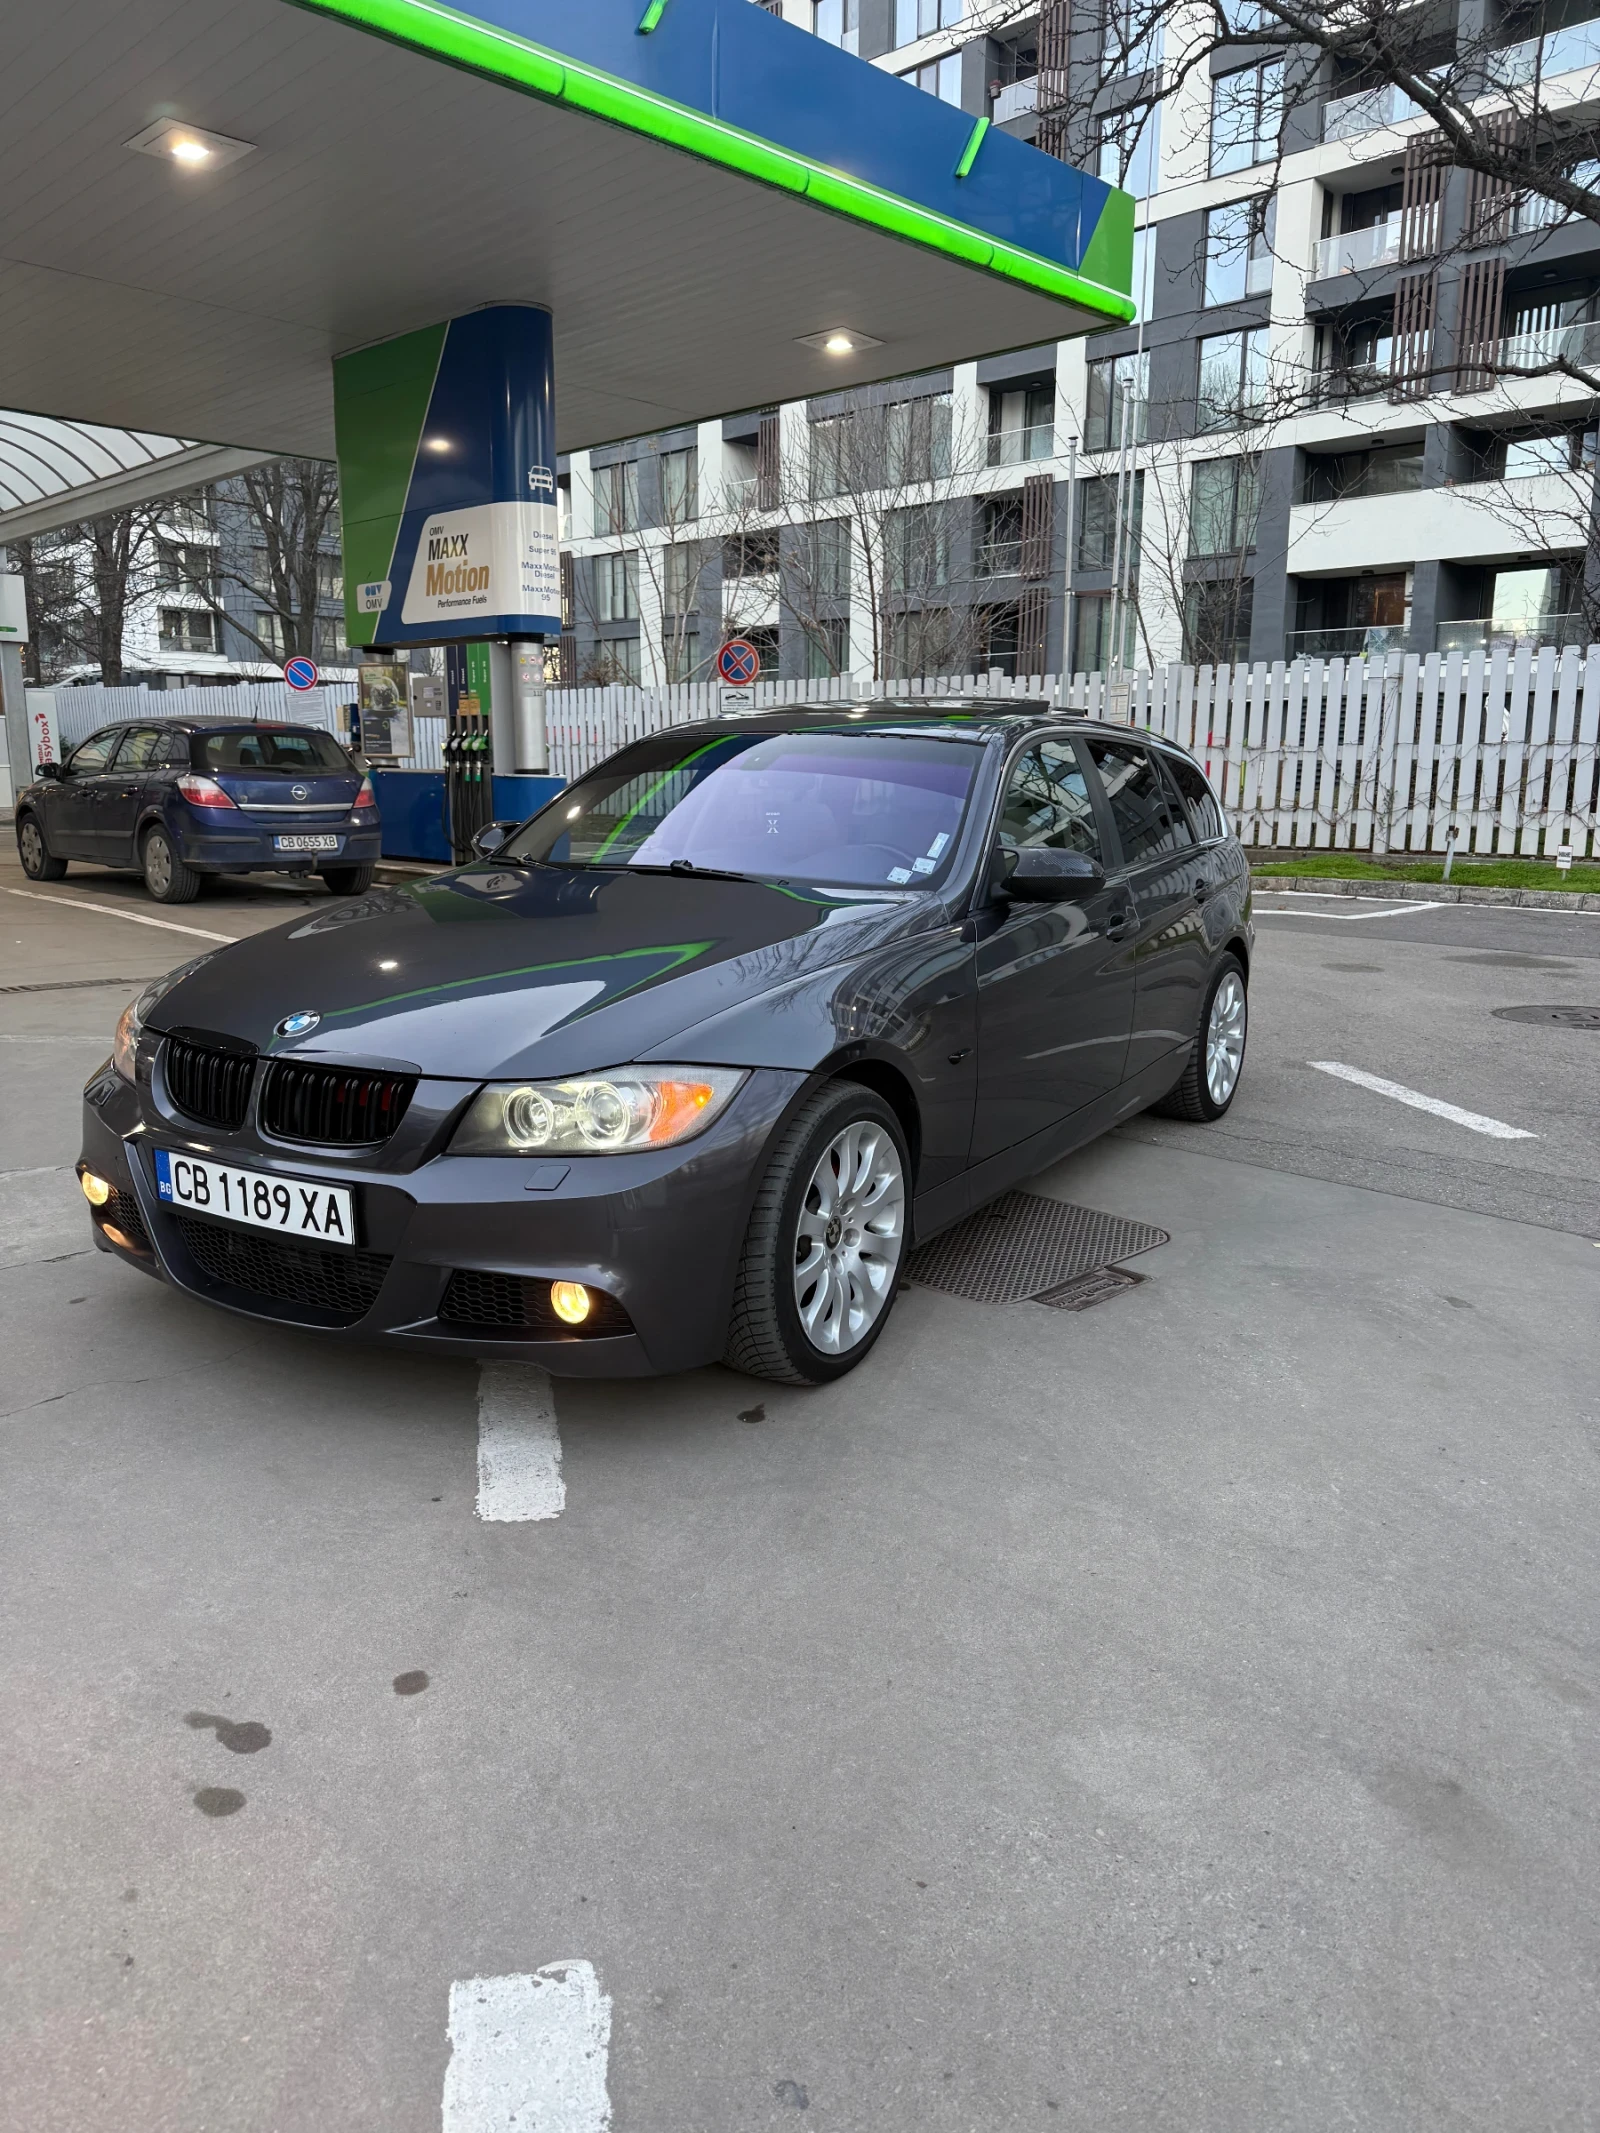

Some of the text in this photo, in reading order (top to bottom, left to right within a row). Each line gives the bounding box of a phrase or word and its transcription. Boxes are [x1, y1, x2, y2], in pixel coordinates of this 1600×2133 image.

[429, 526, 444, 536] OMV
[532, 530, 554, 541] Diesel
[428, 533, 469, 561] MAXX
[528, 545, 550, 554] Super
[425, 560, 490, 597] Motion
[534, 570, 556, 580] Diesel
[365, 598, 383, 610] OMV
[437, 594, 488, 608] Performance Fuels
[541, 594, 551, 602] 95
[41, 720, 54, 763] asybox
[280, 836, 336, 848] CB 0655 XB
[159, 1181, 172, 1195] BG
[174, 1160, 345, 1237] CB 1189 XA
